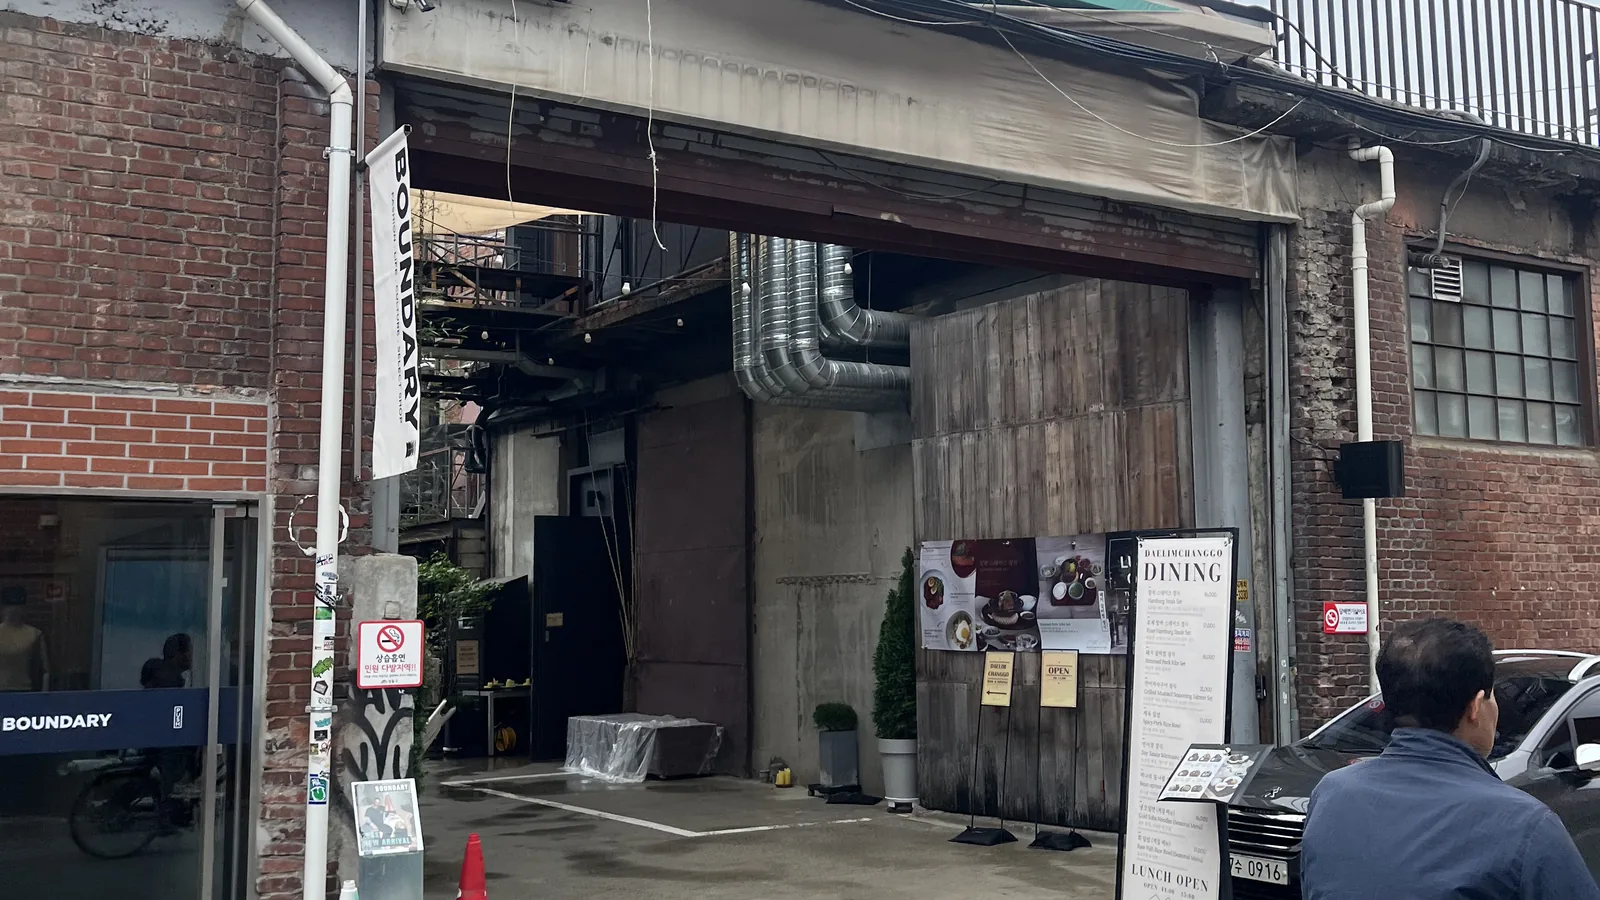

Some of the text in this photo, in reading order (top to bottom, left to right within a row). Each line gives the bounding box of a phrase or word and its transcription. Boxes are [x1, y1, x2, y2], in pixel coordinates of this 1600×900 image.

[395, 147, 418, 430] BOUNDARY
[1144, 549, 1223, 558] DAELIMCHANGGO
[1144, 562, 1221, 583] DINING
[376, 653, 406, 663] 상습흡연
[365, 663, 416, 673] 민원 다발지역!!
[2, 713, 112, 731] BOUNDARY
[374, 784, 409, 792] BOUNDARY
[381, 838, 411, 846] ARRIVAL
[1248, 860, 1281, 881] 0916
[1132, 863, 1208, 892] LUNCH OPEN
[1143, 882, 1158, 890] OPEN
